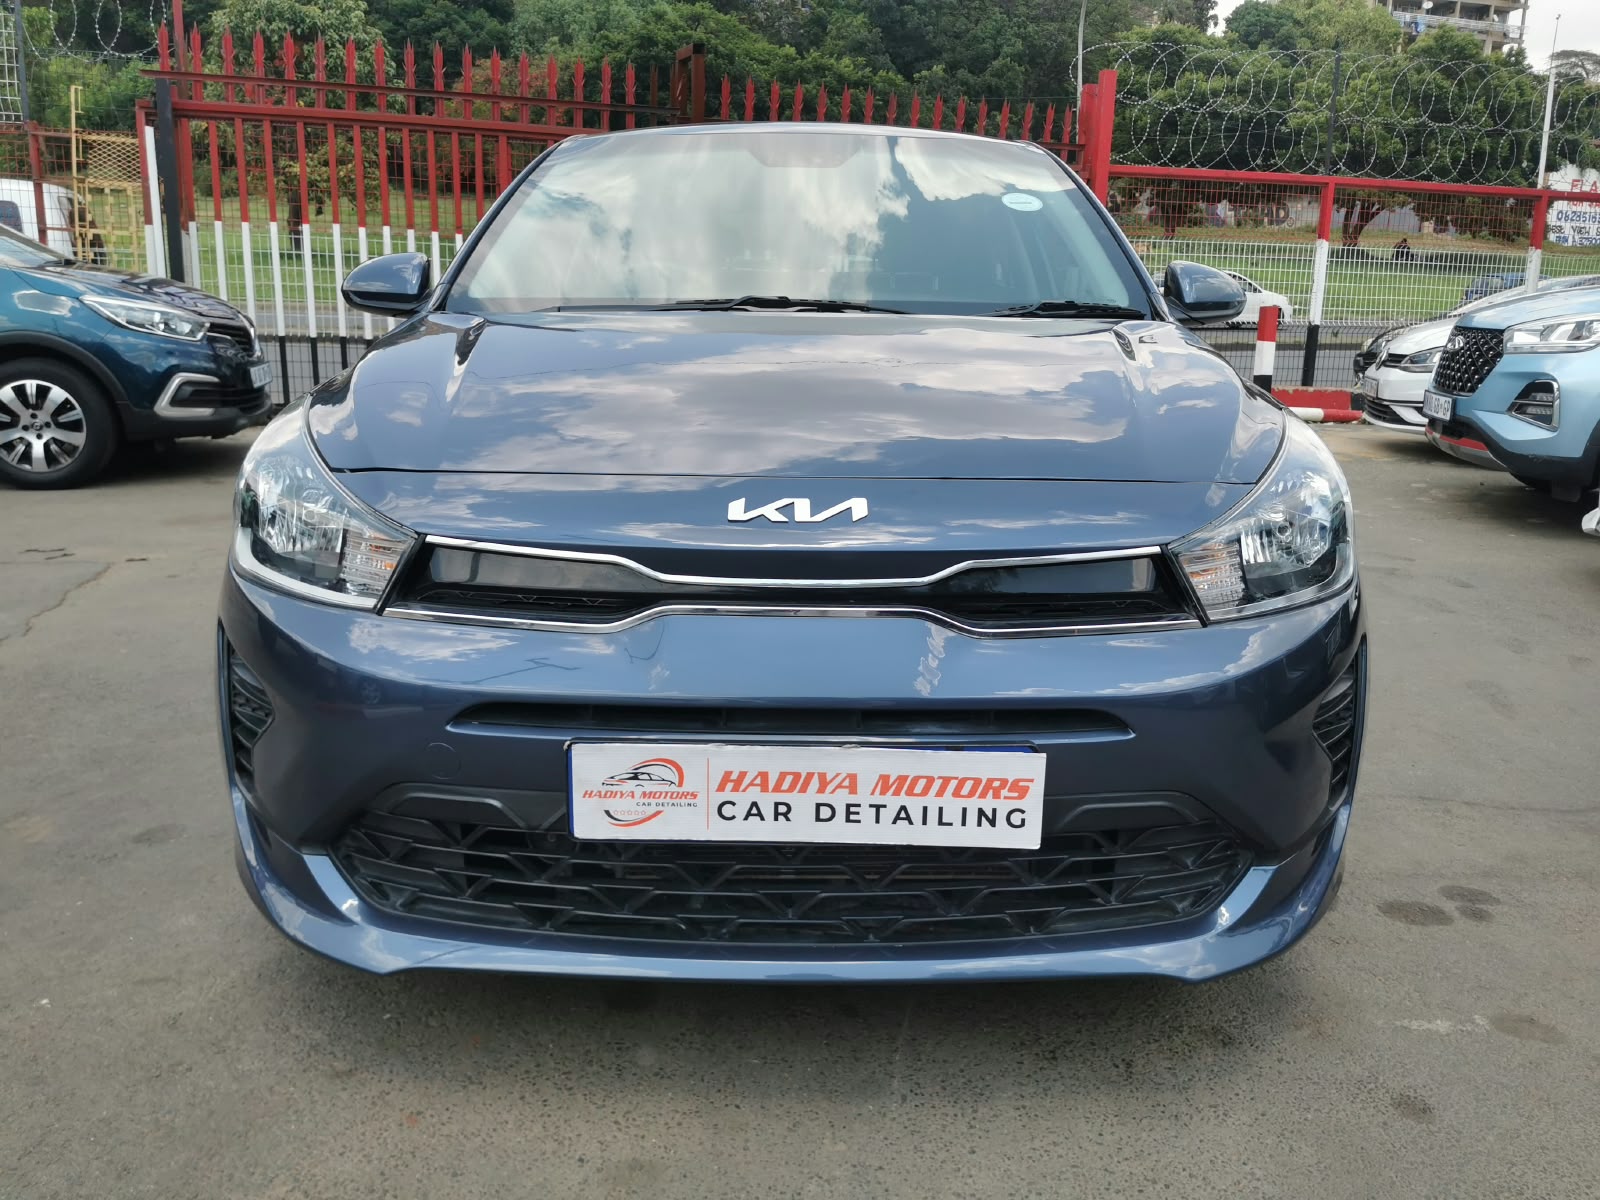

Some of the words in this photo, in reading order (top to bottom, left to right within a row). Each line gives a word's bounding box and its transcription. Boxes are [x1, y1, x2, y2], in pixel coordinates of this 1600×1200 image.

[728, 497, 869, 523] KIA
[582, 790, 636, 800] HADIYA
[640, 790, 700, 800] MOTORS
[717, 770, 858, 795] HADIYA
[870, 773, 1035, 801] MOTORS
[655, 801, 698, 809] DETAILING
[717, 800, 792, 822] CAR
[815, 802, 1026, 829] DETAILING
